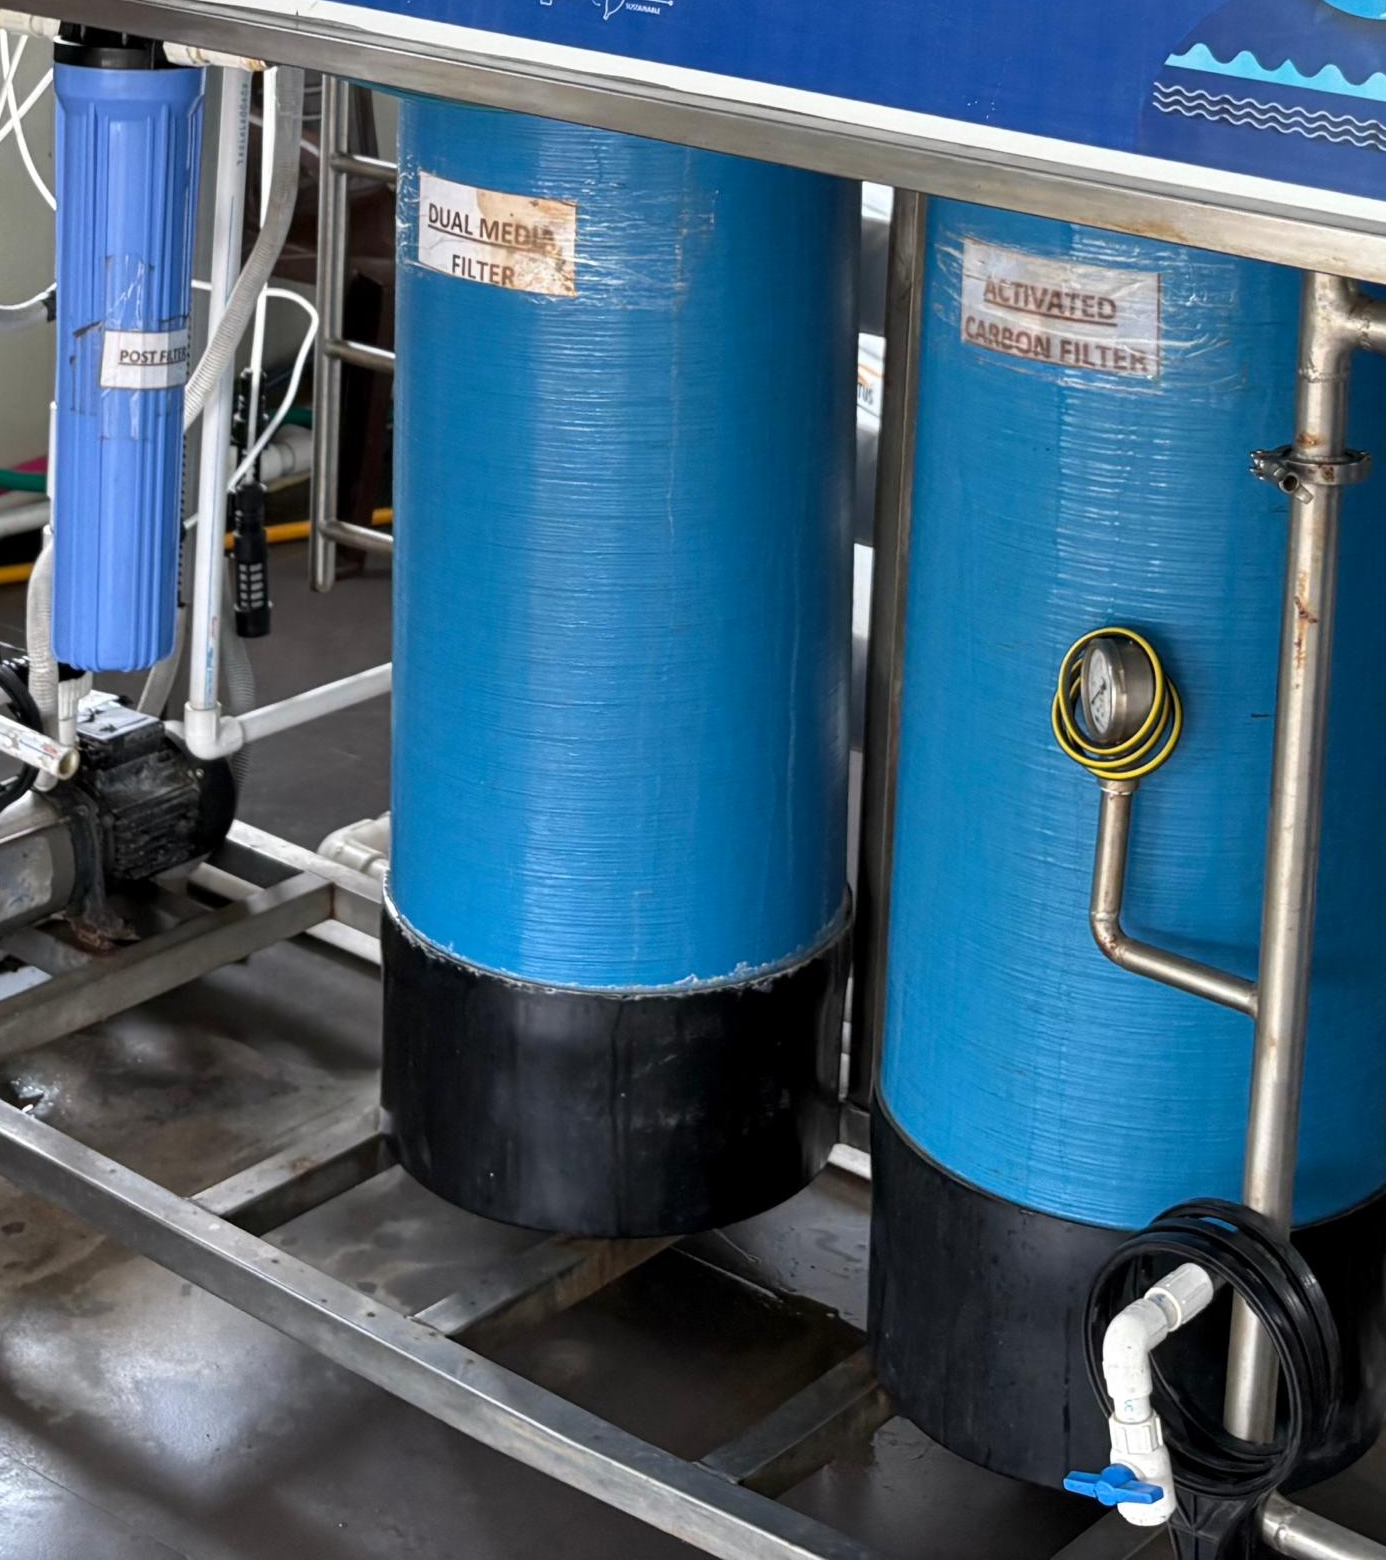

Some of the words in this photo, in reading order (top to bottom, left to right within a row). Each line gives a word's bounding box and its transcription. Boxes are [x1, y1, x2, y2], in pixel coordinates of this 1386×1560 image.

[429, 202, 473, 236] DUAL
[452, 254, 515, 285] FILTER
[983, 278, 1118, 320] ACTIVATED
[120, 349, 157, 363] POST
[965, 315, 1051, 358] CARBON
[1060, 339, 1148, 373] FILTER
